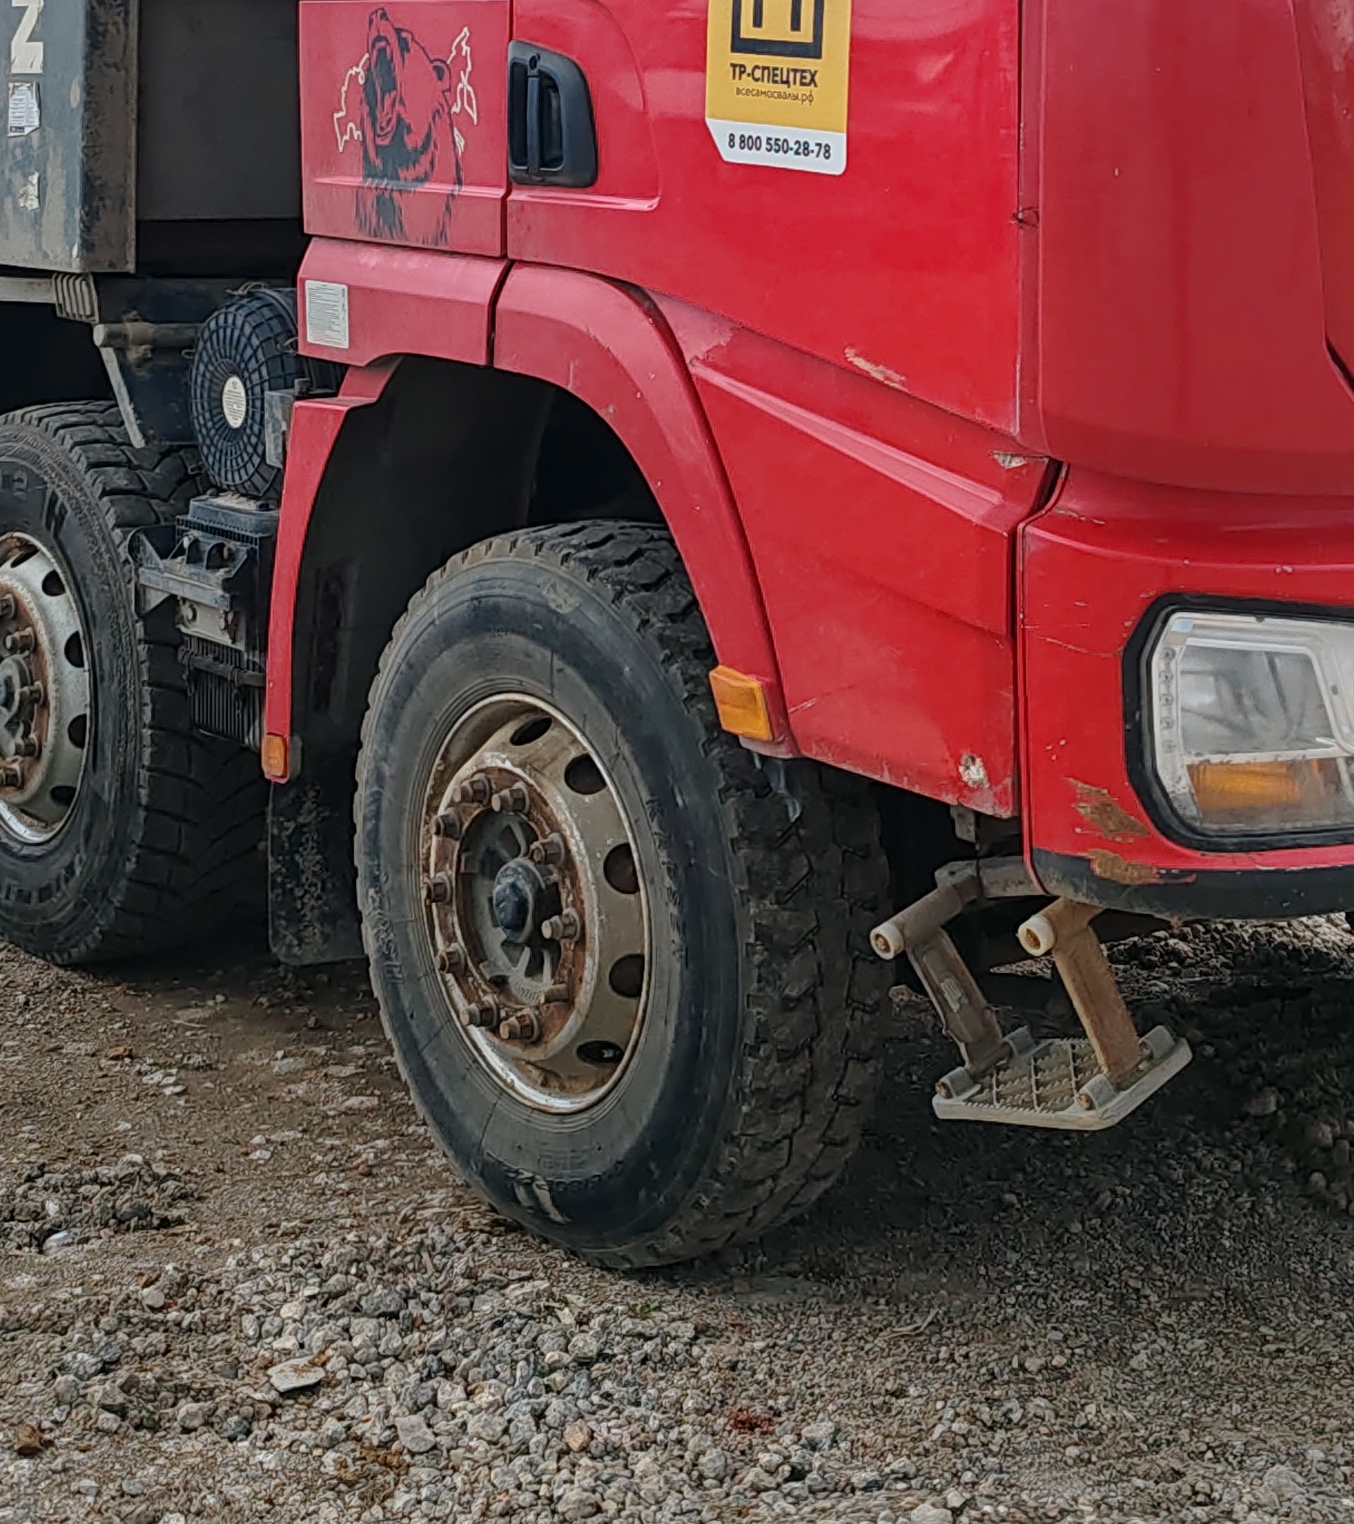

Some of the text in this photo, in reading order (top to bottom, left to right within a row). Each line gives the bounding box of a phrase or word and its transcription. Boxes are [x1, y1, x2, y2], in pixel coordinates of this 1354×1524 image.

[729, 62, 819, 88] ТР-СПЕЦТЕХ
[735, 87, 815, 106] всесамосвалы.рф
[728, 132, 832, 160] 8 800 550-28-78
